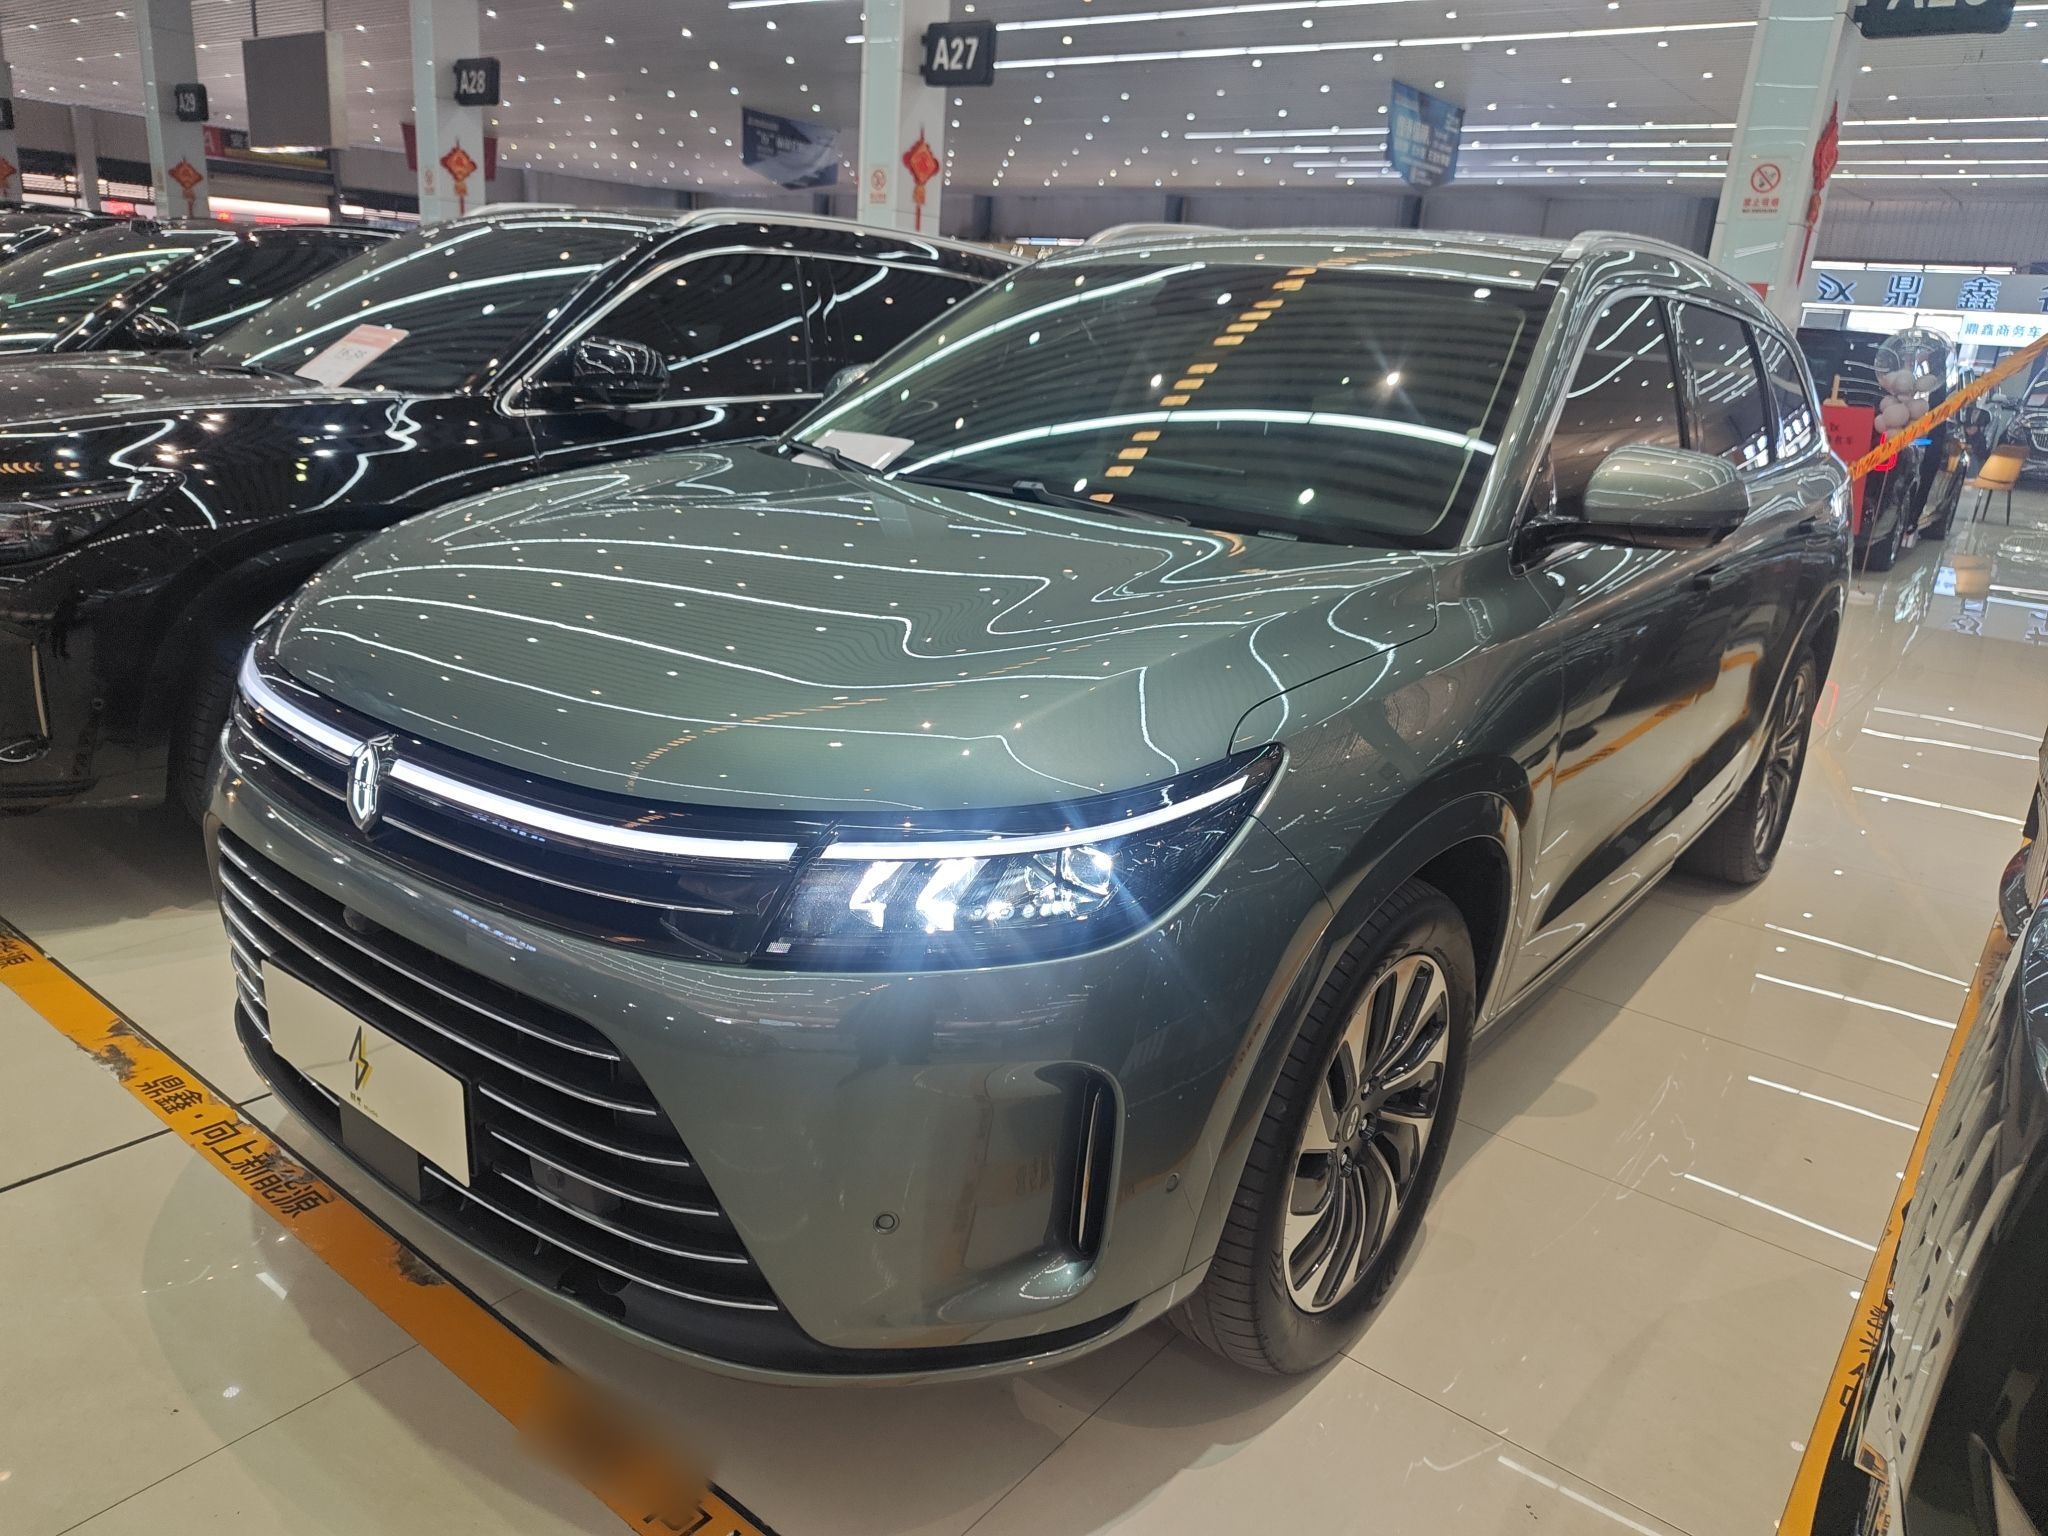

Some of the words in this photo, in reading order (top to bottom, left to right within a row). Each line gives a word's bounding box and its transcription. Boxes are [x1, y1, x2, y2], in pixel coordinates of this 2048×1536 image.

[932, 36, 979, 71] A27
[460, 69, 487, 95] A28
[179, 92, 196, 113] A29
[1882, 273, 2048, 314] 鼎鑫
[1964, 322, 2043, 338] 鼎鑫商务车
